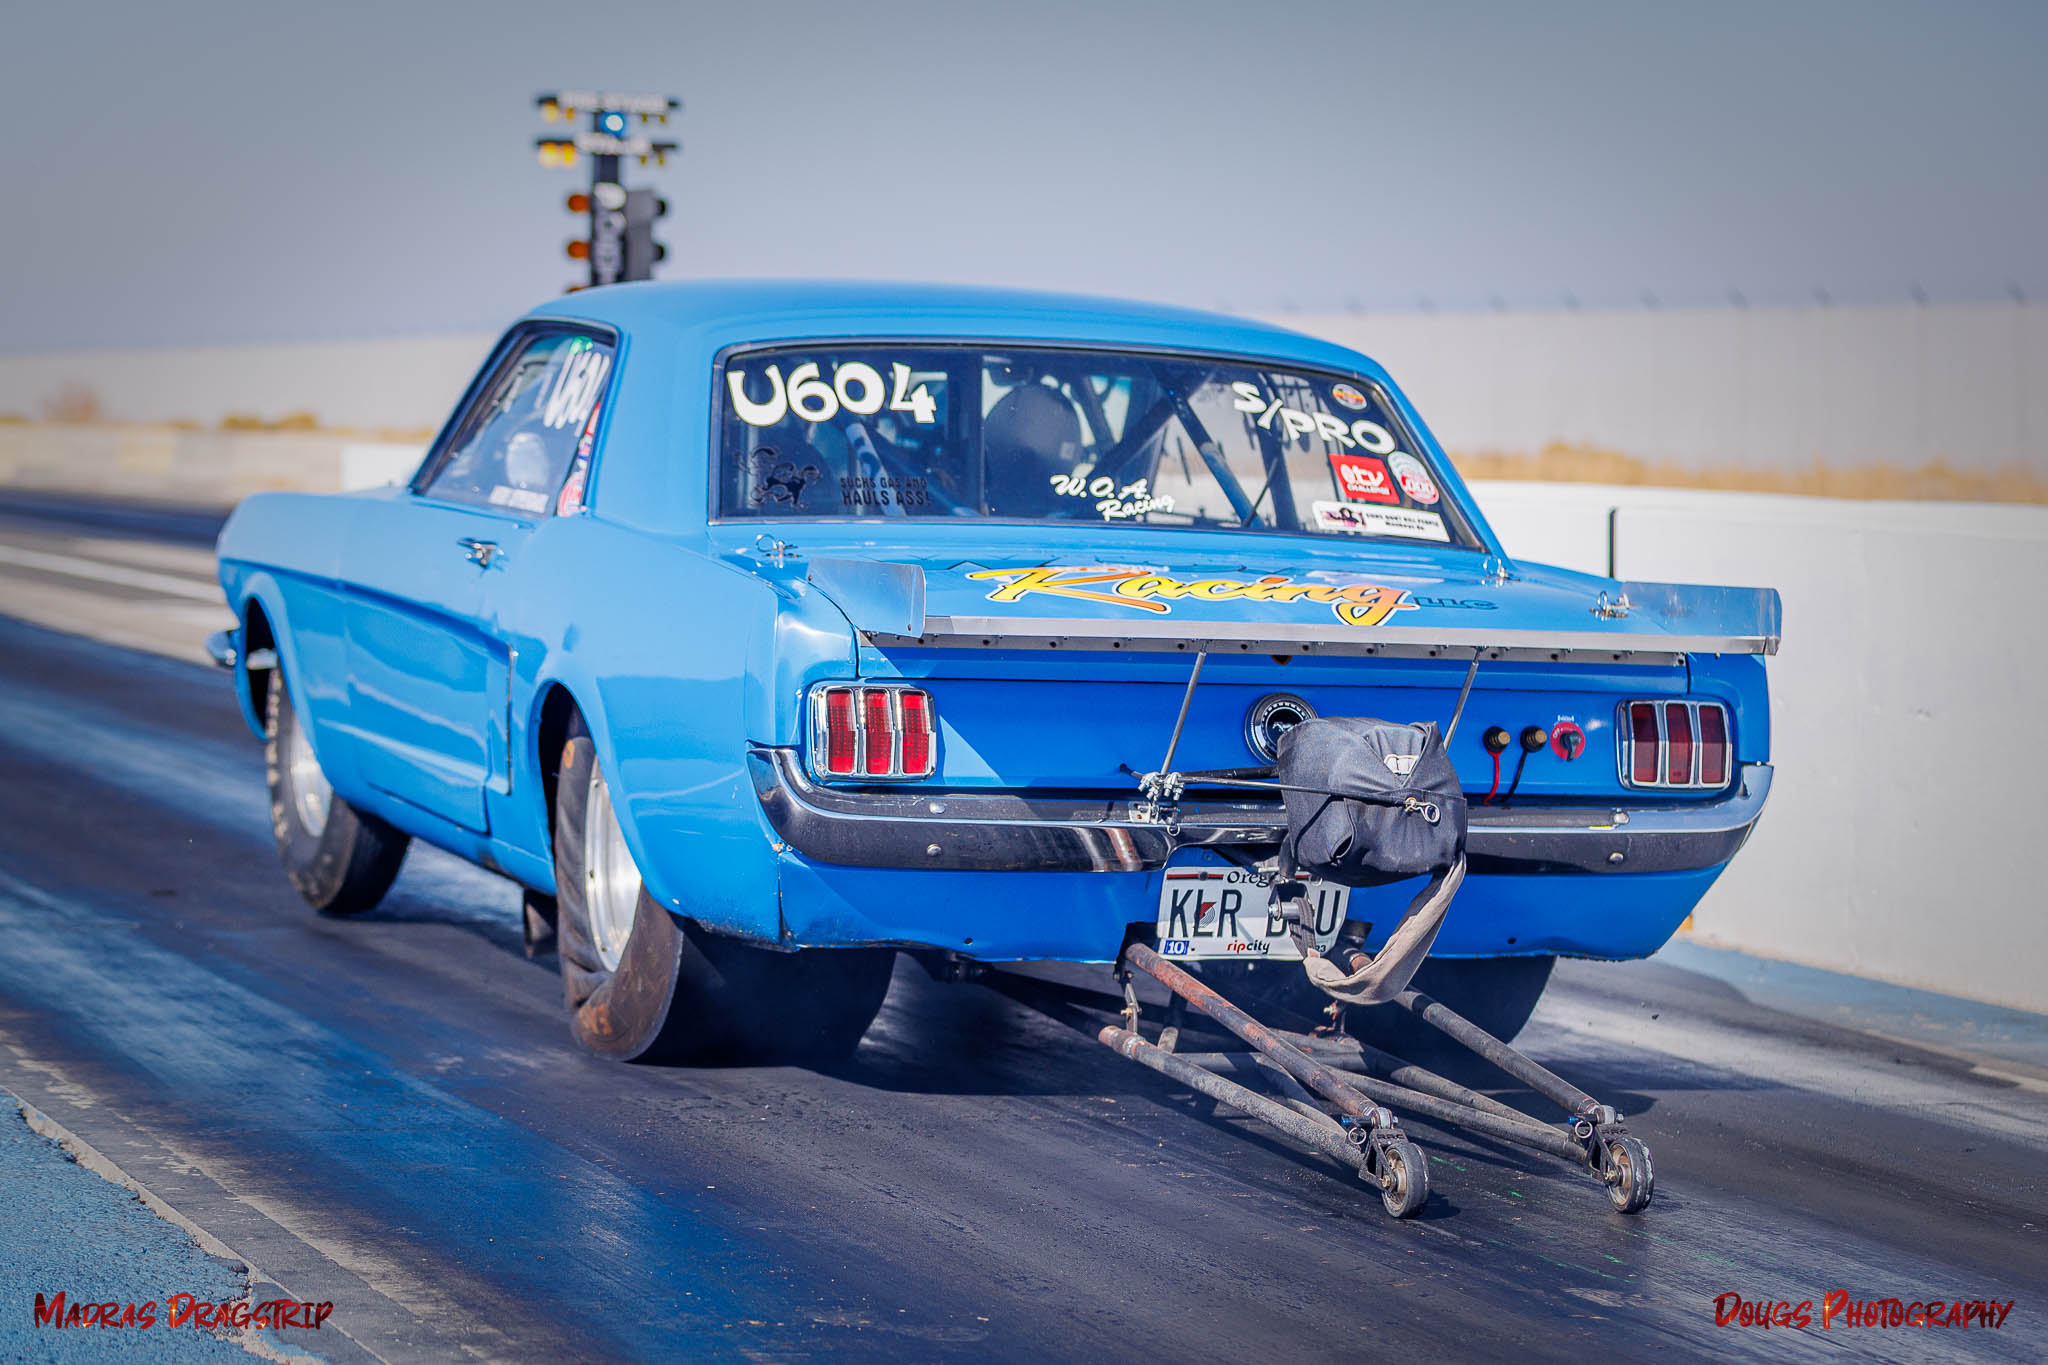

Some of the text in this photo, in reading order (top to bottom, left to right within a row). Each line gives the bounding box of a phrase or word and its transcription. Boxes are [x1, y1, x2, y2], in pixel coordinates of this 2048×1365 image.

[727, 361, 937, 426] U604
[1231, 381, 1396, 454] S/PRO
[840, 476, 928, 489] SUCKS GAS AND
[842, 490, 930, 506] HAULS ASS!
[1096, 494, 1176, 522] Racing
[965, 566, 1421, 626] Racing
[1227, 870, 1270, 888] Oreg
[1168, 889, 1242, 937] KLR
[1167, 940, 1185, 954] 10
[1227, 940, 1271, 955] ripcity
